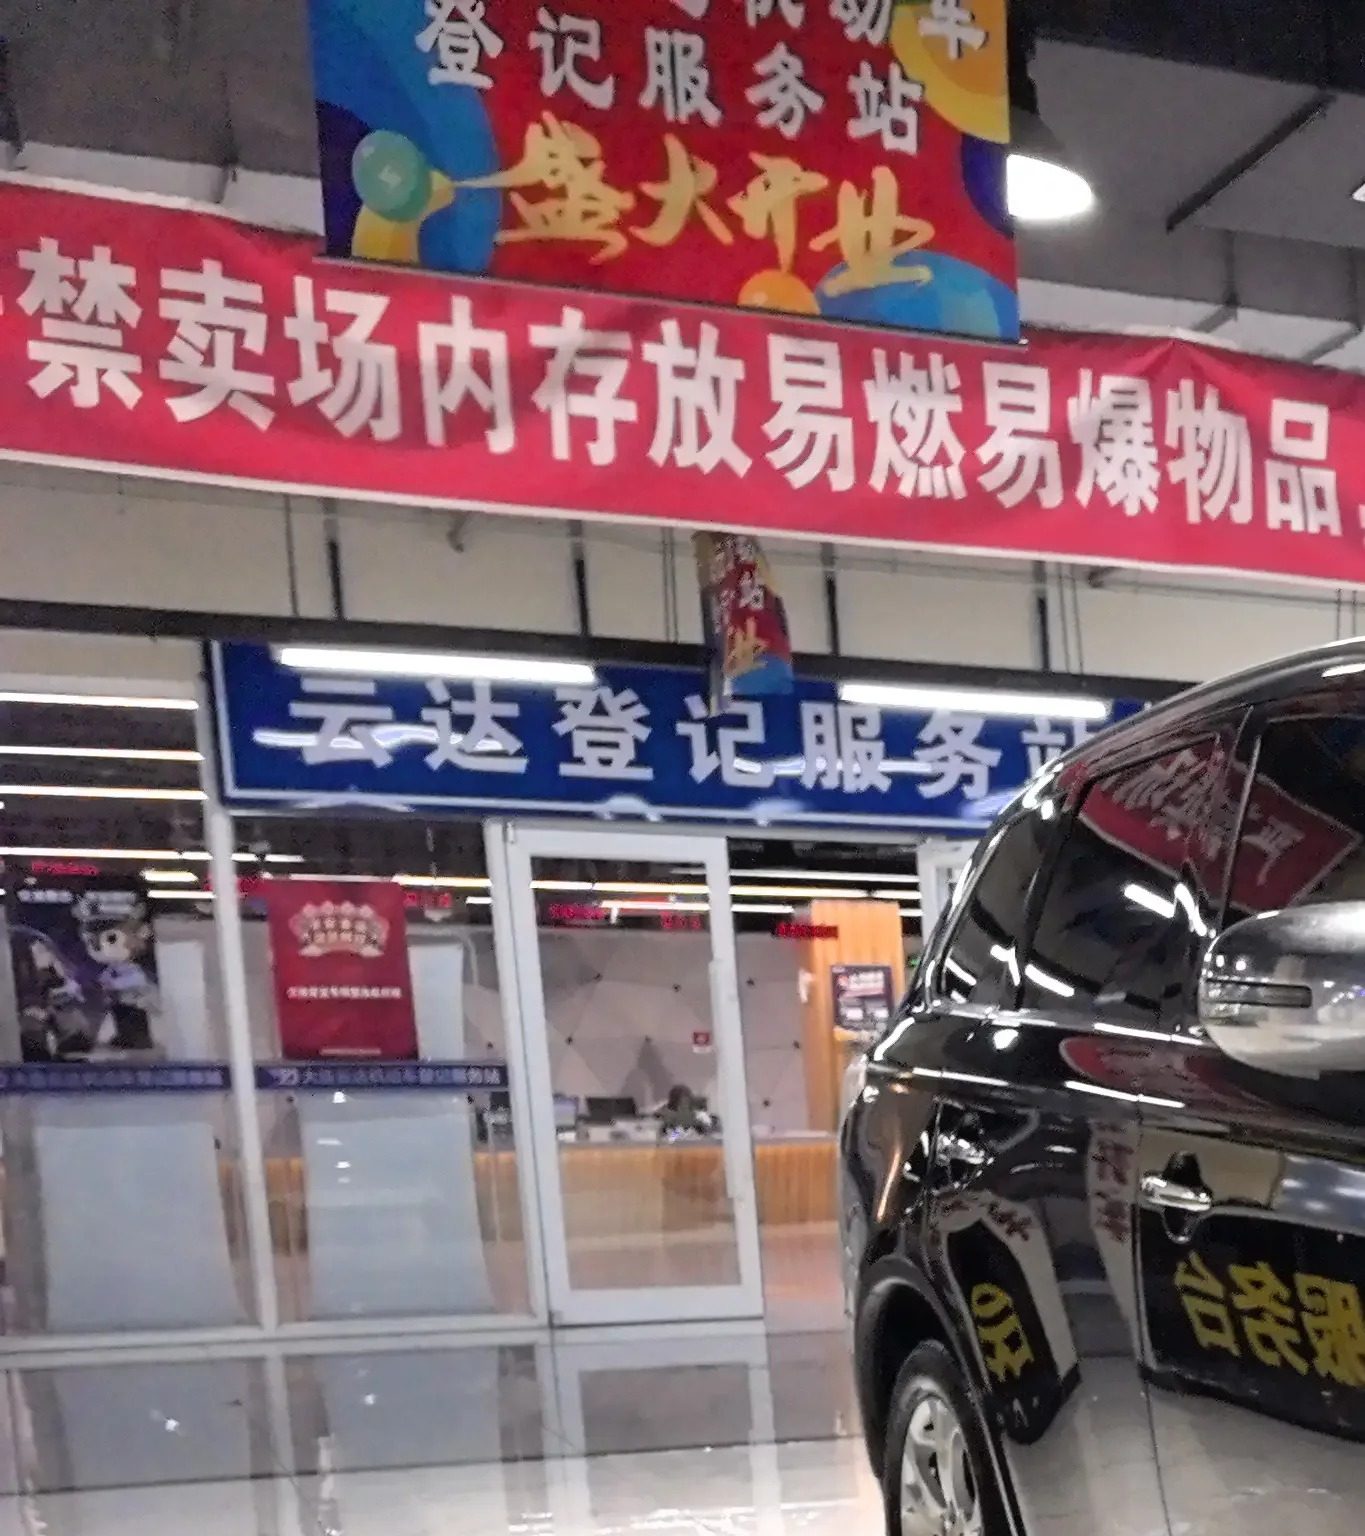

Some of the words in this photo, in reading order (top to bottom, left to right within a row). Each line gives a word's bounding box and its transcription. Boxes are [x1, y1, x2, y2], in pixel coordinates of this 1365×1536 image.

[415, 0, 923, 155] 登记服务站
[466, 111, 935, 299] 盛大开业
